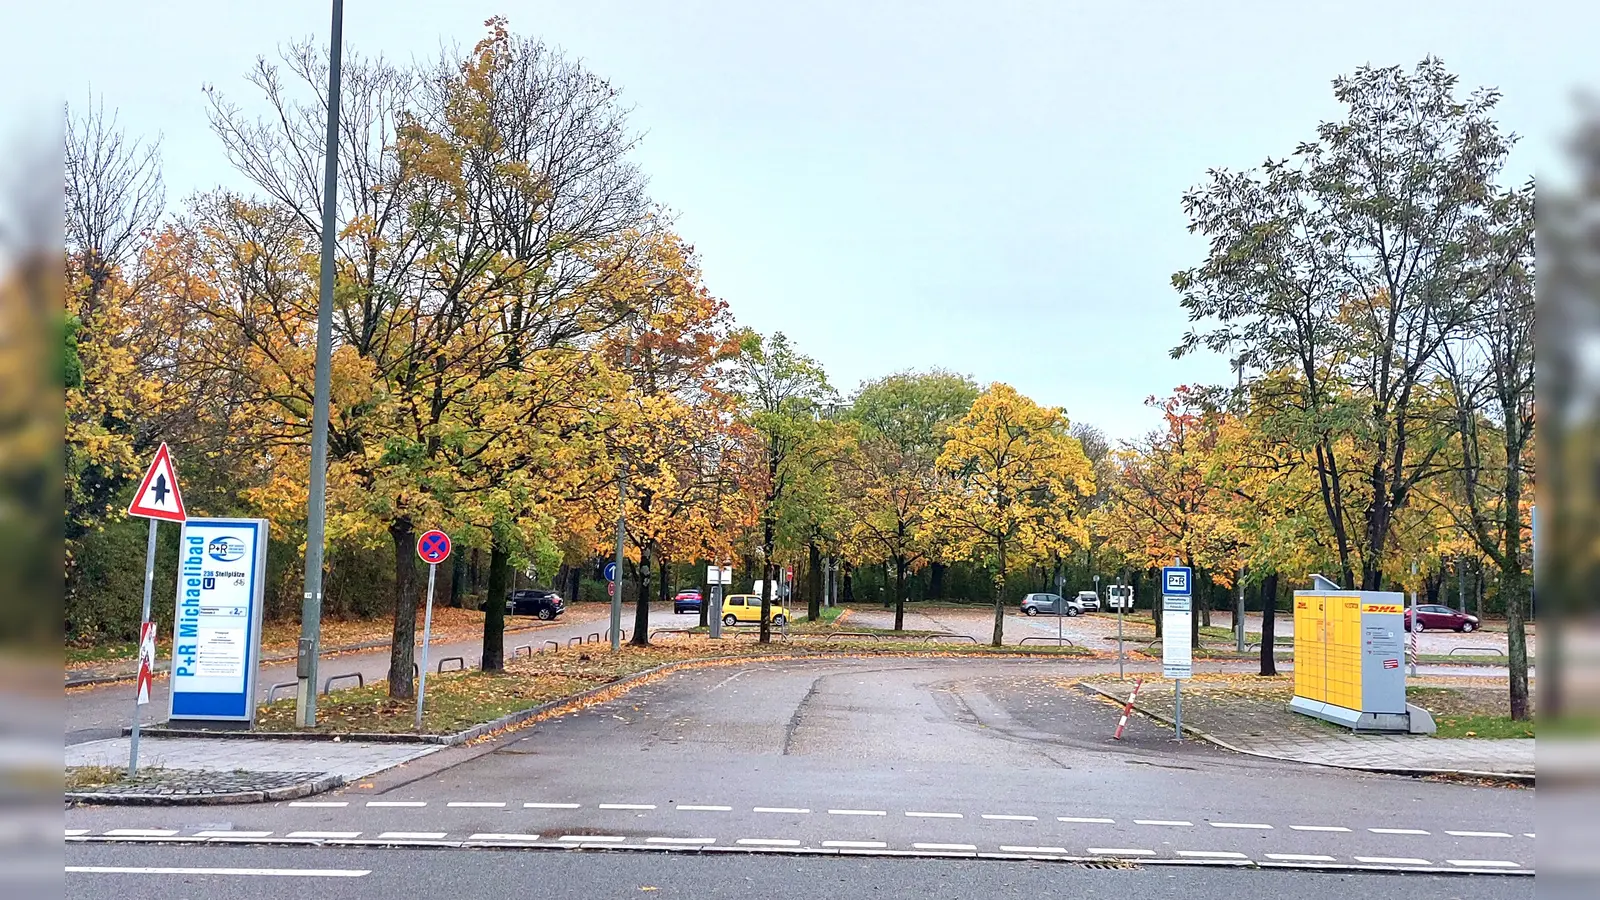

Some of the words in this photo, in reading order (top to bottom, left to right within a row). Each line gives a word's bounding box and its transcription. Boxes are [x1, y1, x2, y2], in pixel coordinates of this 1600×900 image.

[208, 543, 228, 554] P+R
[215, 570, 245, 578] Stellplätze
[204, 578, 213, 588] U
[1169, 577, 1185, 585] P+R
[179, 536, 204, 637] Michaelibad
[1368, 605, 1397, 613] DHL
[176, 644, 197, 677] P+R
